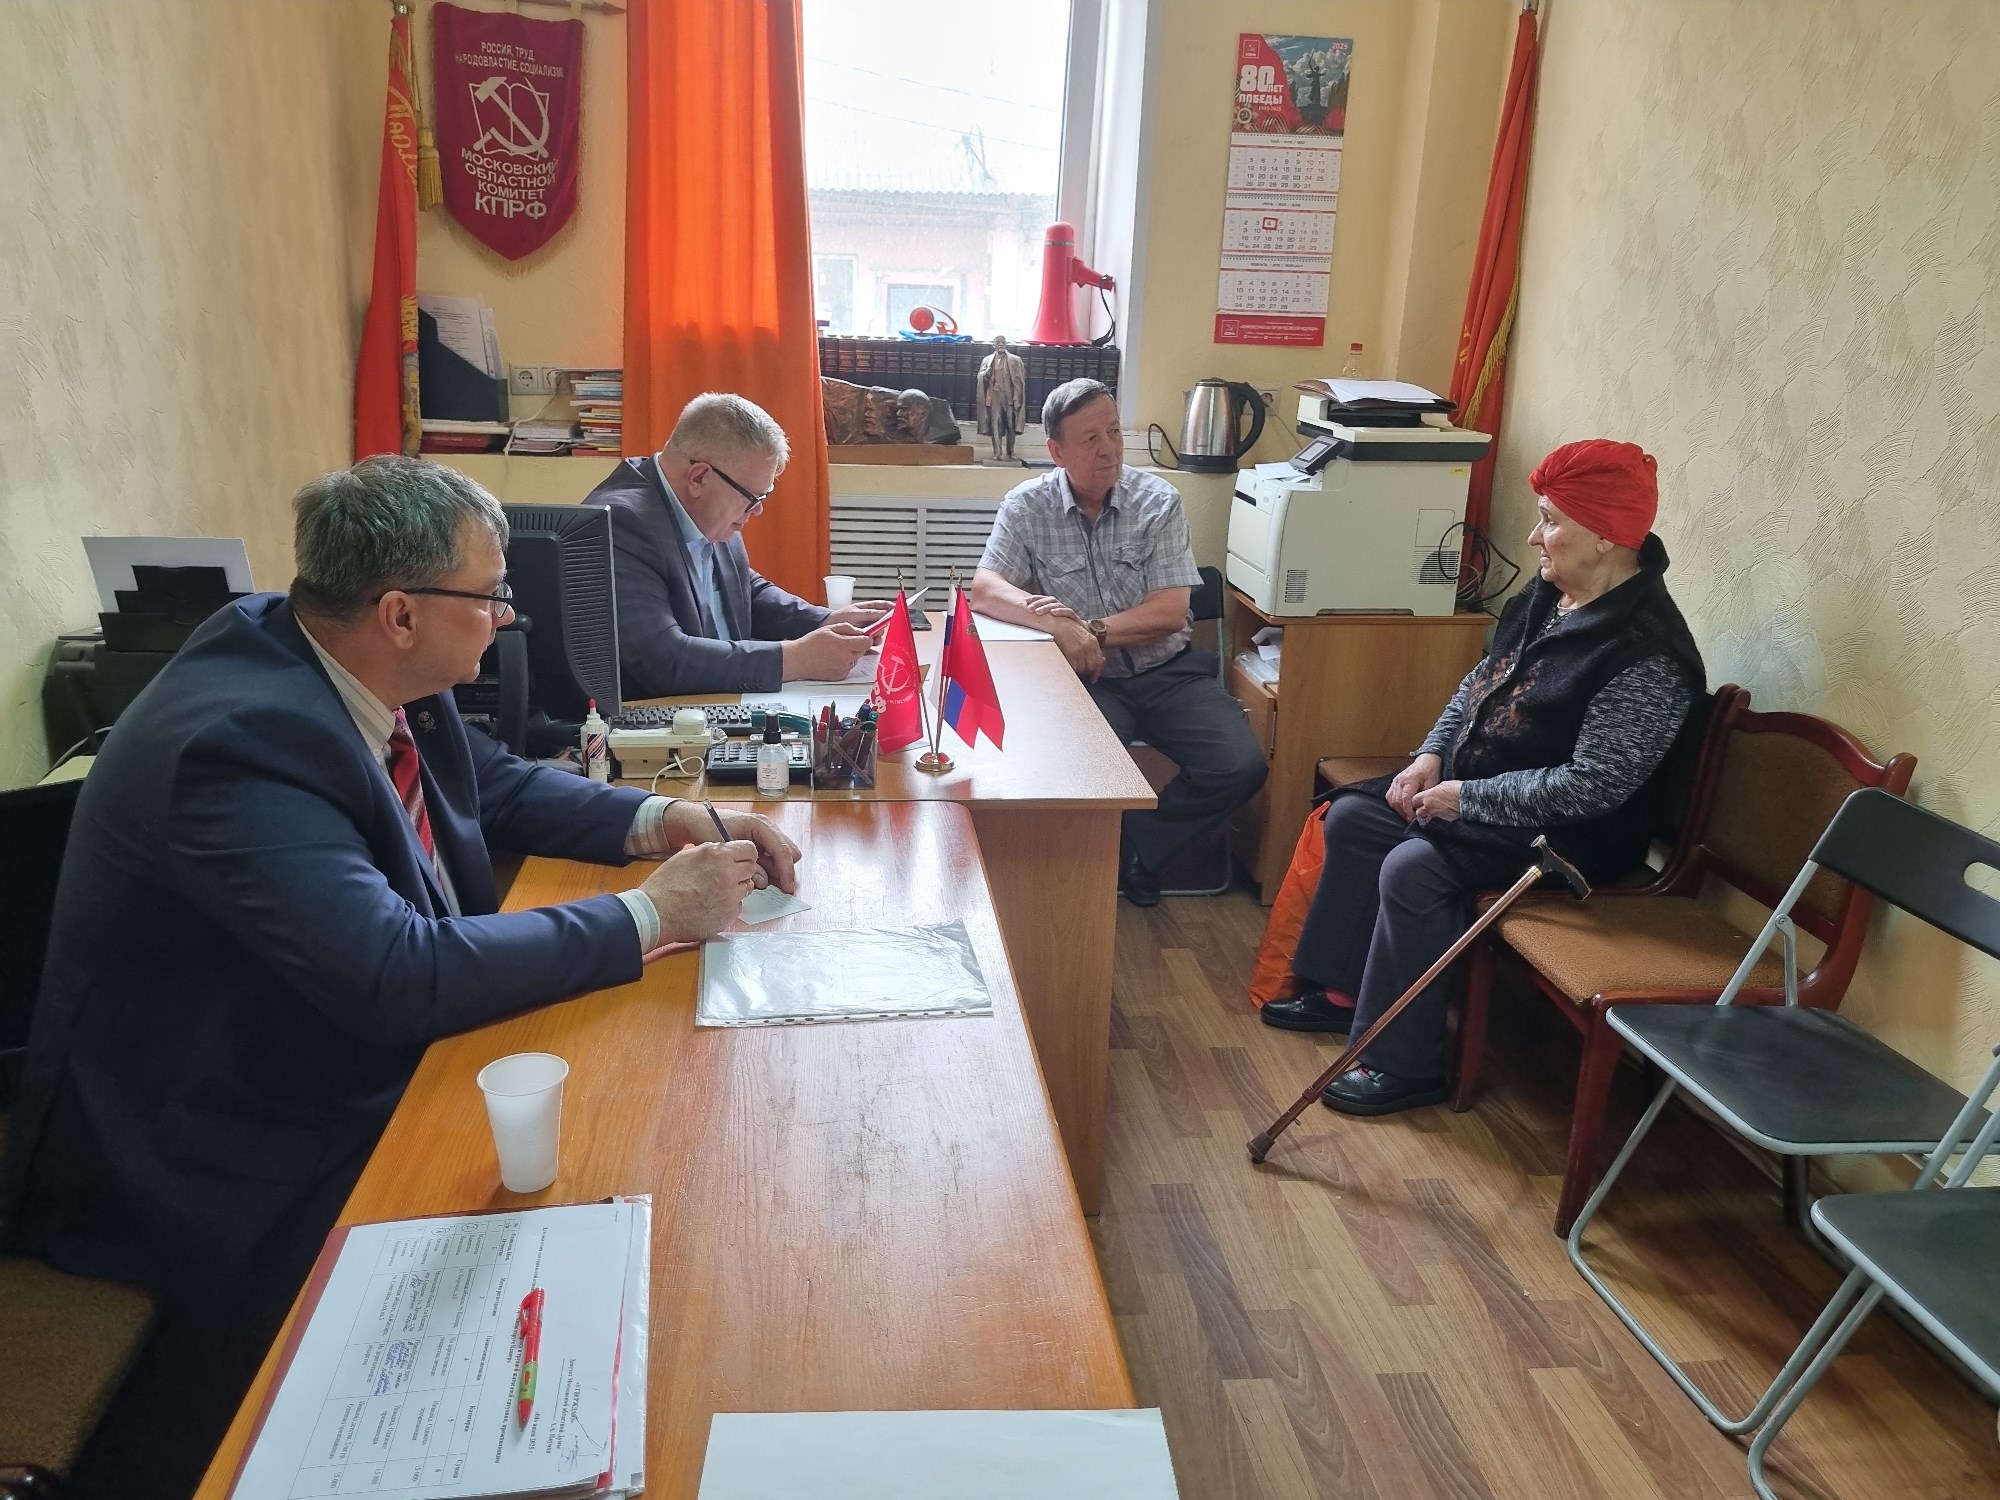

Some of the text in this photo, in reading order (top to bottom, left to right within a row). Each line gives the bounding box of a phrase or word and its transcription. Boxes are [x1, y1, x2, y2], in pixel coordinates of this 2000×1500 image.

[1240, 65, 1284, 93] 80 ЛЕТ
[1239, 94, 1283, 105] ПОБЕДЫ
[461, 148, 558, 176] МОСКОВСКИЙ
[465, 163, 556, 187] ОБЛАСТНОЙ
[478, 180, 546, 200] КОМИТЕТ
[475, 192, 547, 220] КПРФ
